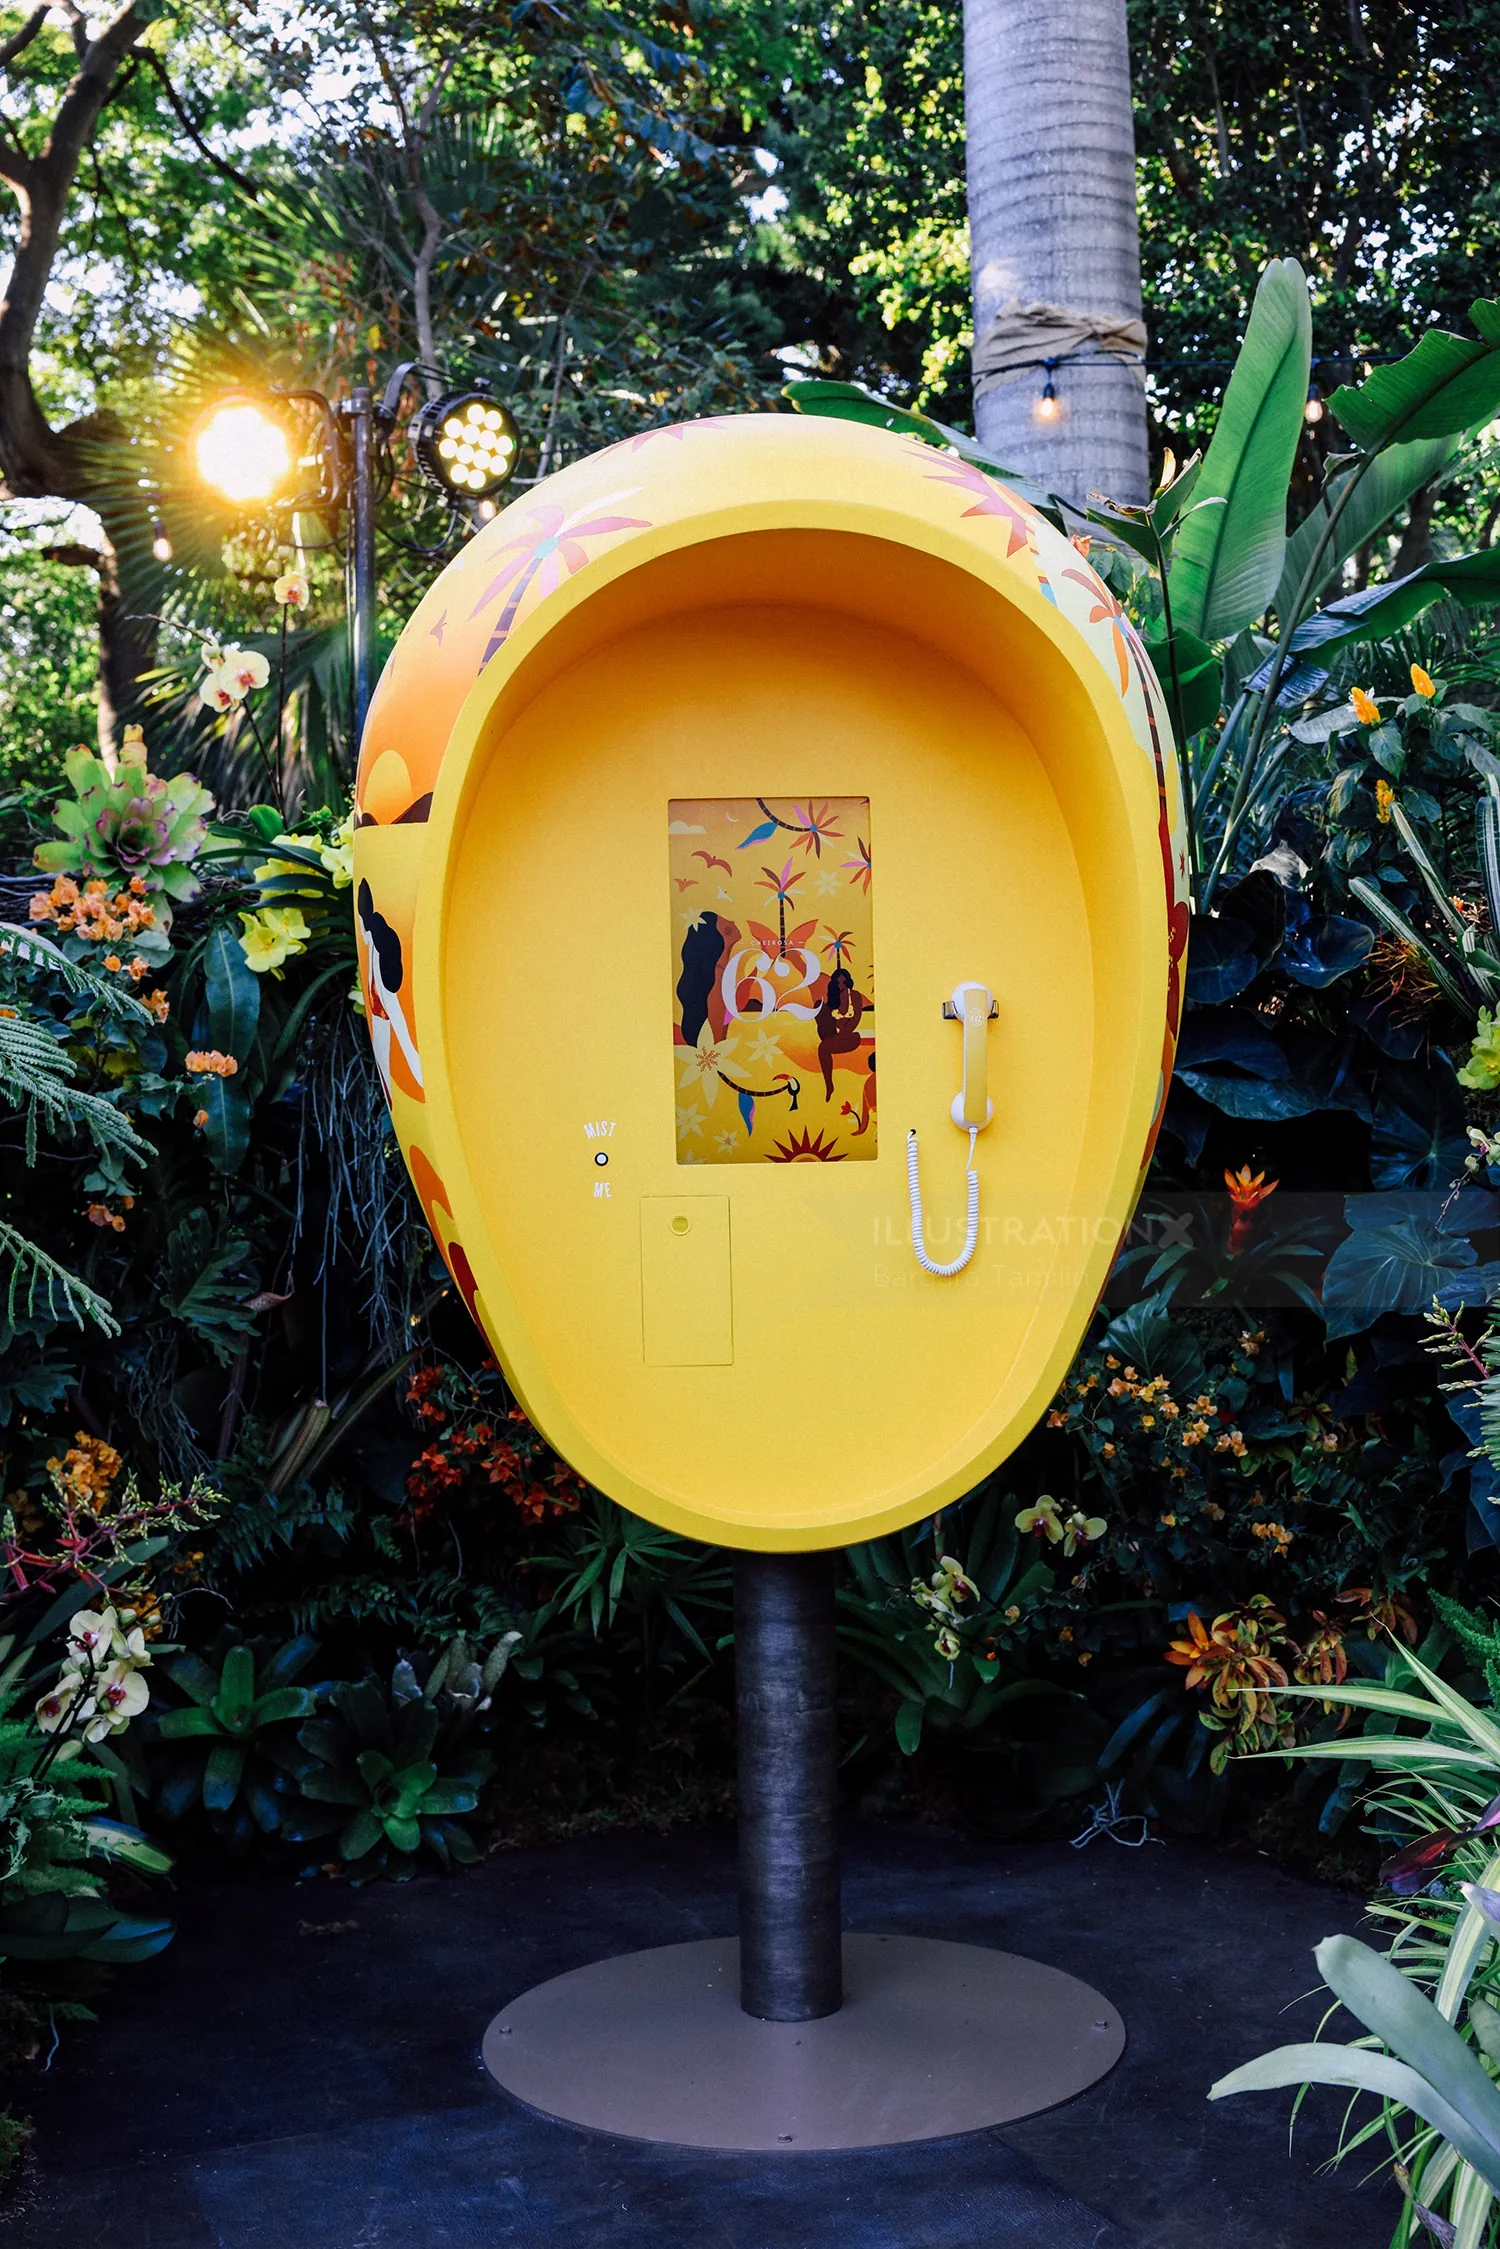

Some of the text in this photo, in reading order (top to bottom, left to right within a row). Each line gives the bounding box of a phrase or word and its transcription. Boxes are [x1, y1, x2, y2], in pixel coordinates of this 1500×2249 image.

[721, 948, 824, 1023] 62
[584, 1120, 616, 1139] MIST
[593, 1181, 613, 1198] ME
